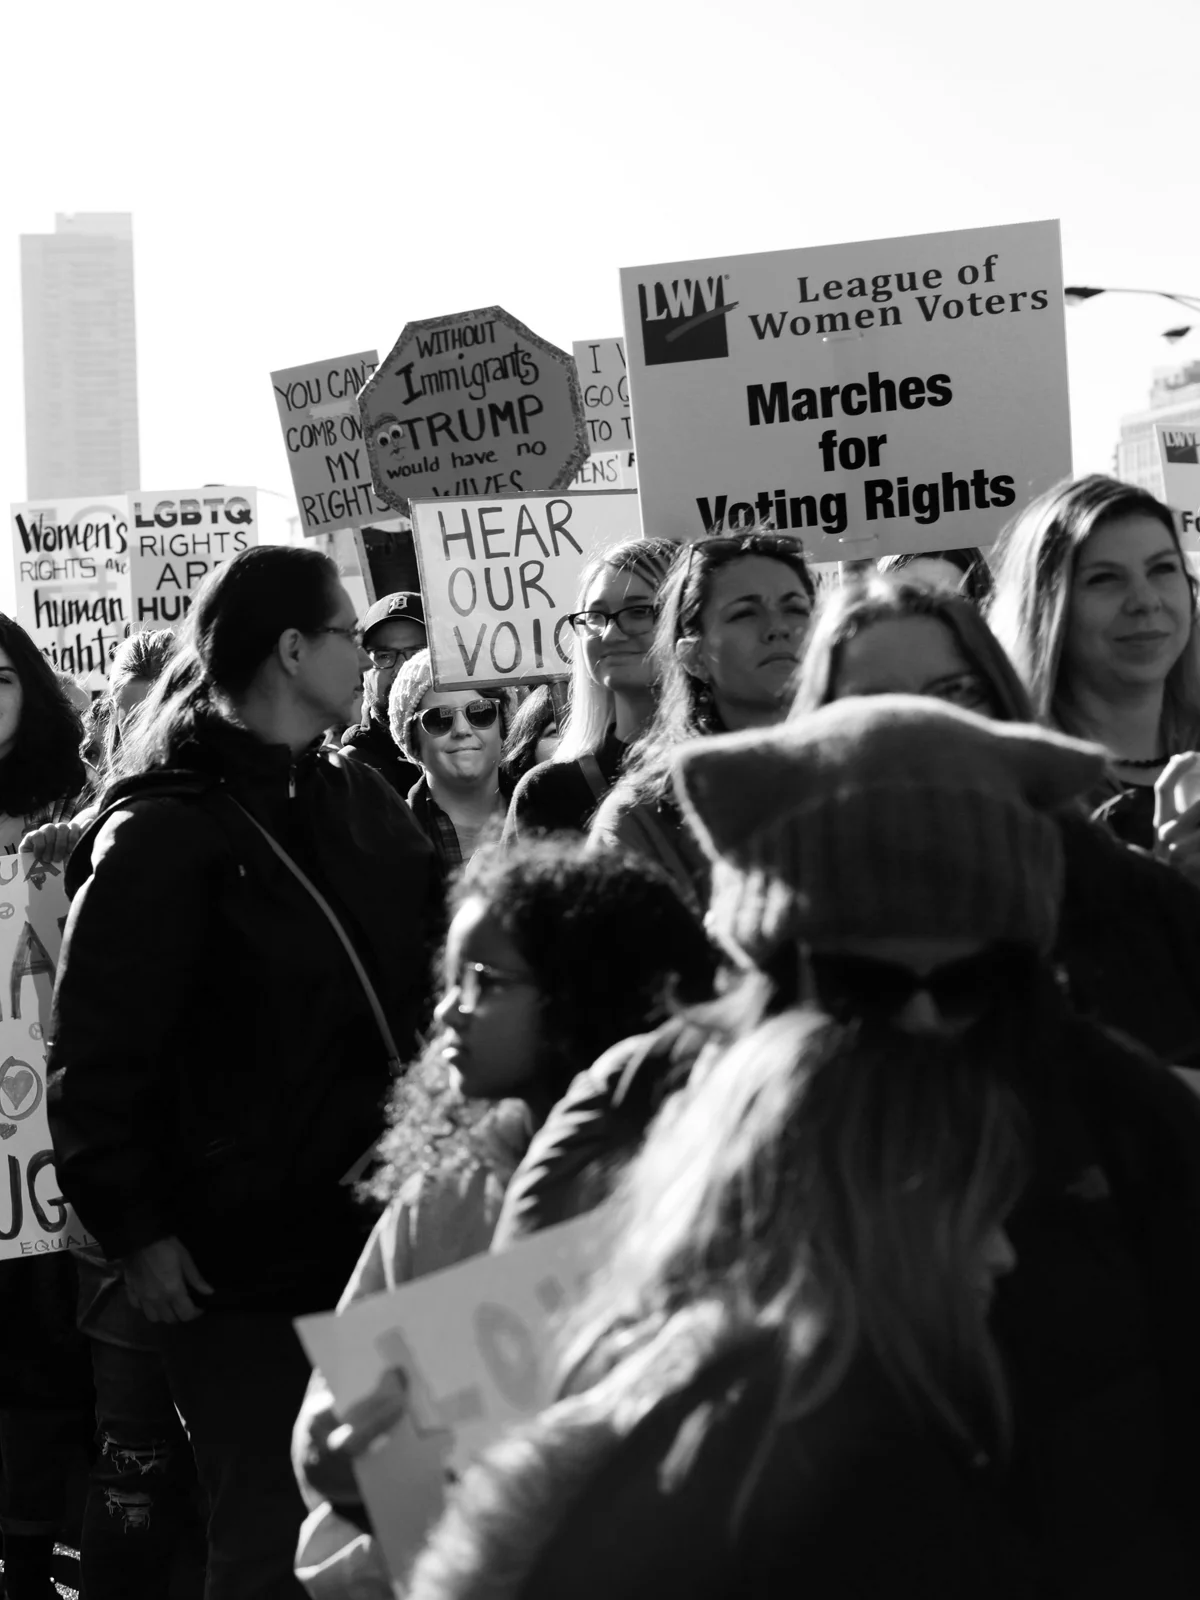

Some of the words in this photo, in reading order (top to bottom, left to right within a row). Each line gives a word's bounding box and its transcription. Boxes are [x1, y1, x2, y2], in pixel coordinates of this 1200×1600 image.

[639, 275, 722, 322] LWV
[797, 263, 943, 304] League
[957, 254, 999, 286] of
[748, 304, 902, 340] Women
[915, 287, 1050, 323] Voters
[416, 320, 497, 359] WITHOUT
[588, 344, 602, 374] I
[395, 342, 540, 405] Immigrants
[274, 378, 322, 411] YOU
[585, 384, 614, 408] GO
[746, 371, 954, 426] Marches
[398, 394, 544, 450] TRUMP
[587, 419, 612, 442] TO
[325, 449, 360, 483] MY
[386, 456, 440, 479] would
[451, 450, 499, 469] have
[516, 440, 547, 456] no
[818, 429, 888, 472] for
[134, 497, 253, 528] LGBTQ
[696, 489, 847, 534] Voting
[864, 467, 1016, 524] Rights
[15, 513, 128, 554] Women's
[140, 531, 248, 557] RIGHTS
[437, 499, 583, 562] HEAR
[20, 557, 96, 582] RIGHTS
[105, 558, 128, 575] are
[155, 560, 224, 590] AR
[447, 560, 556, 617] OUR
[34, 589, 127, 629] human
